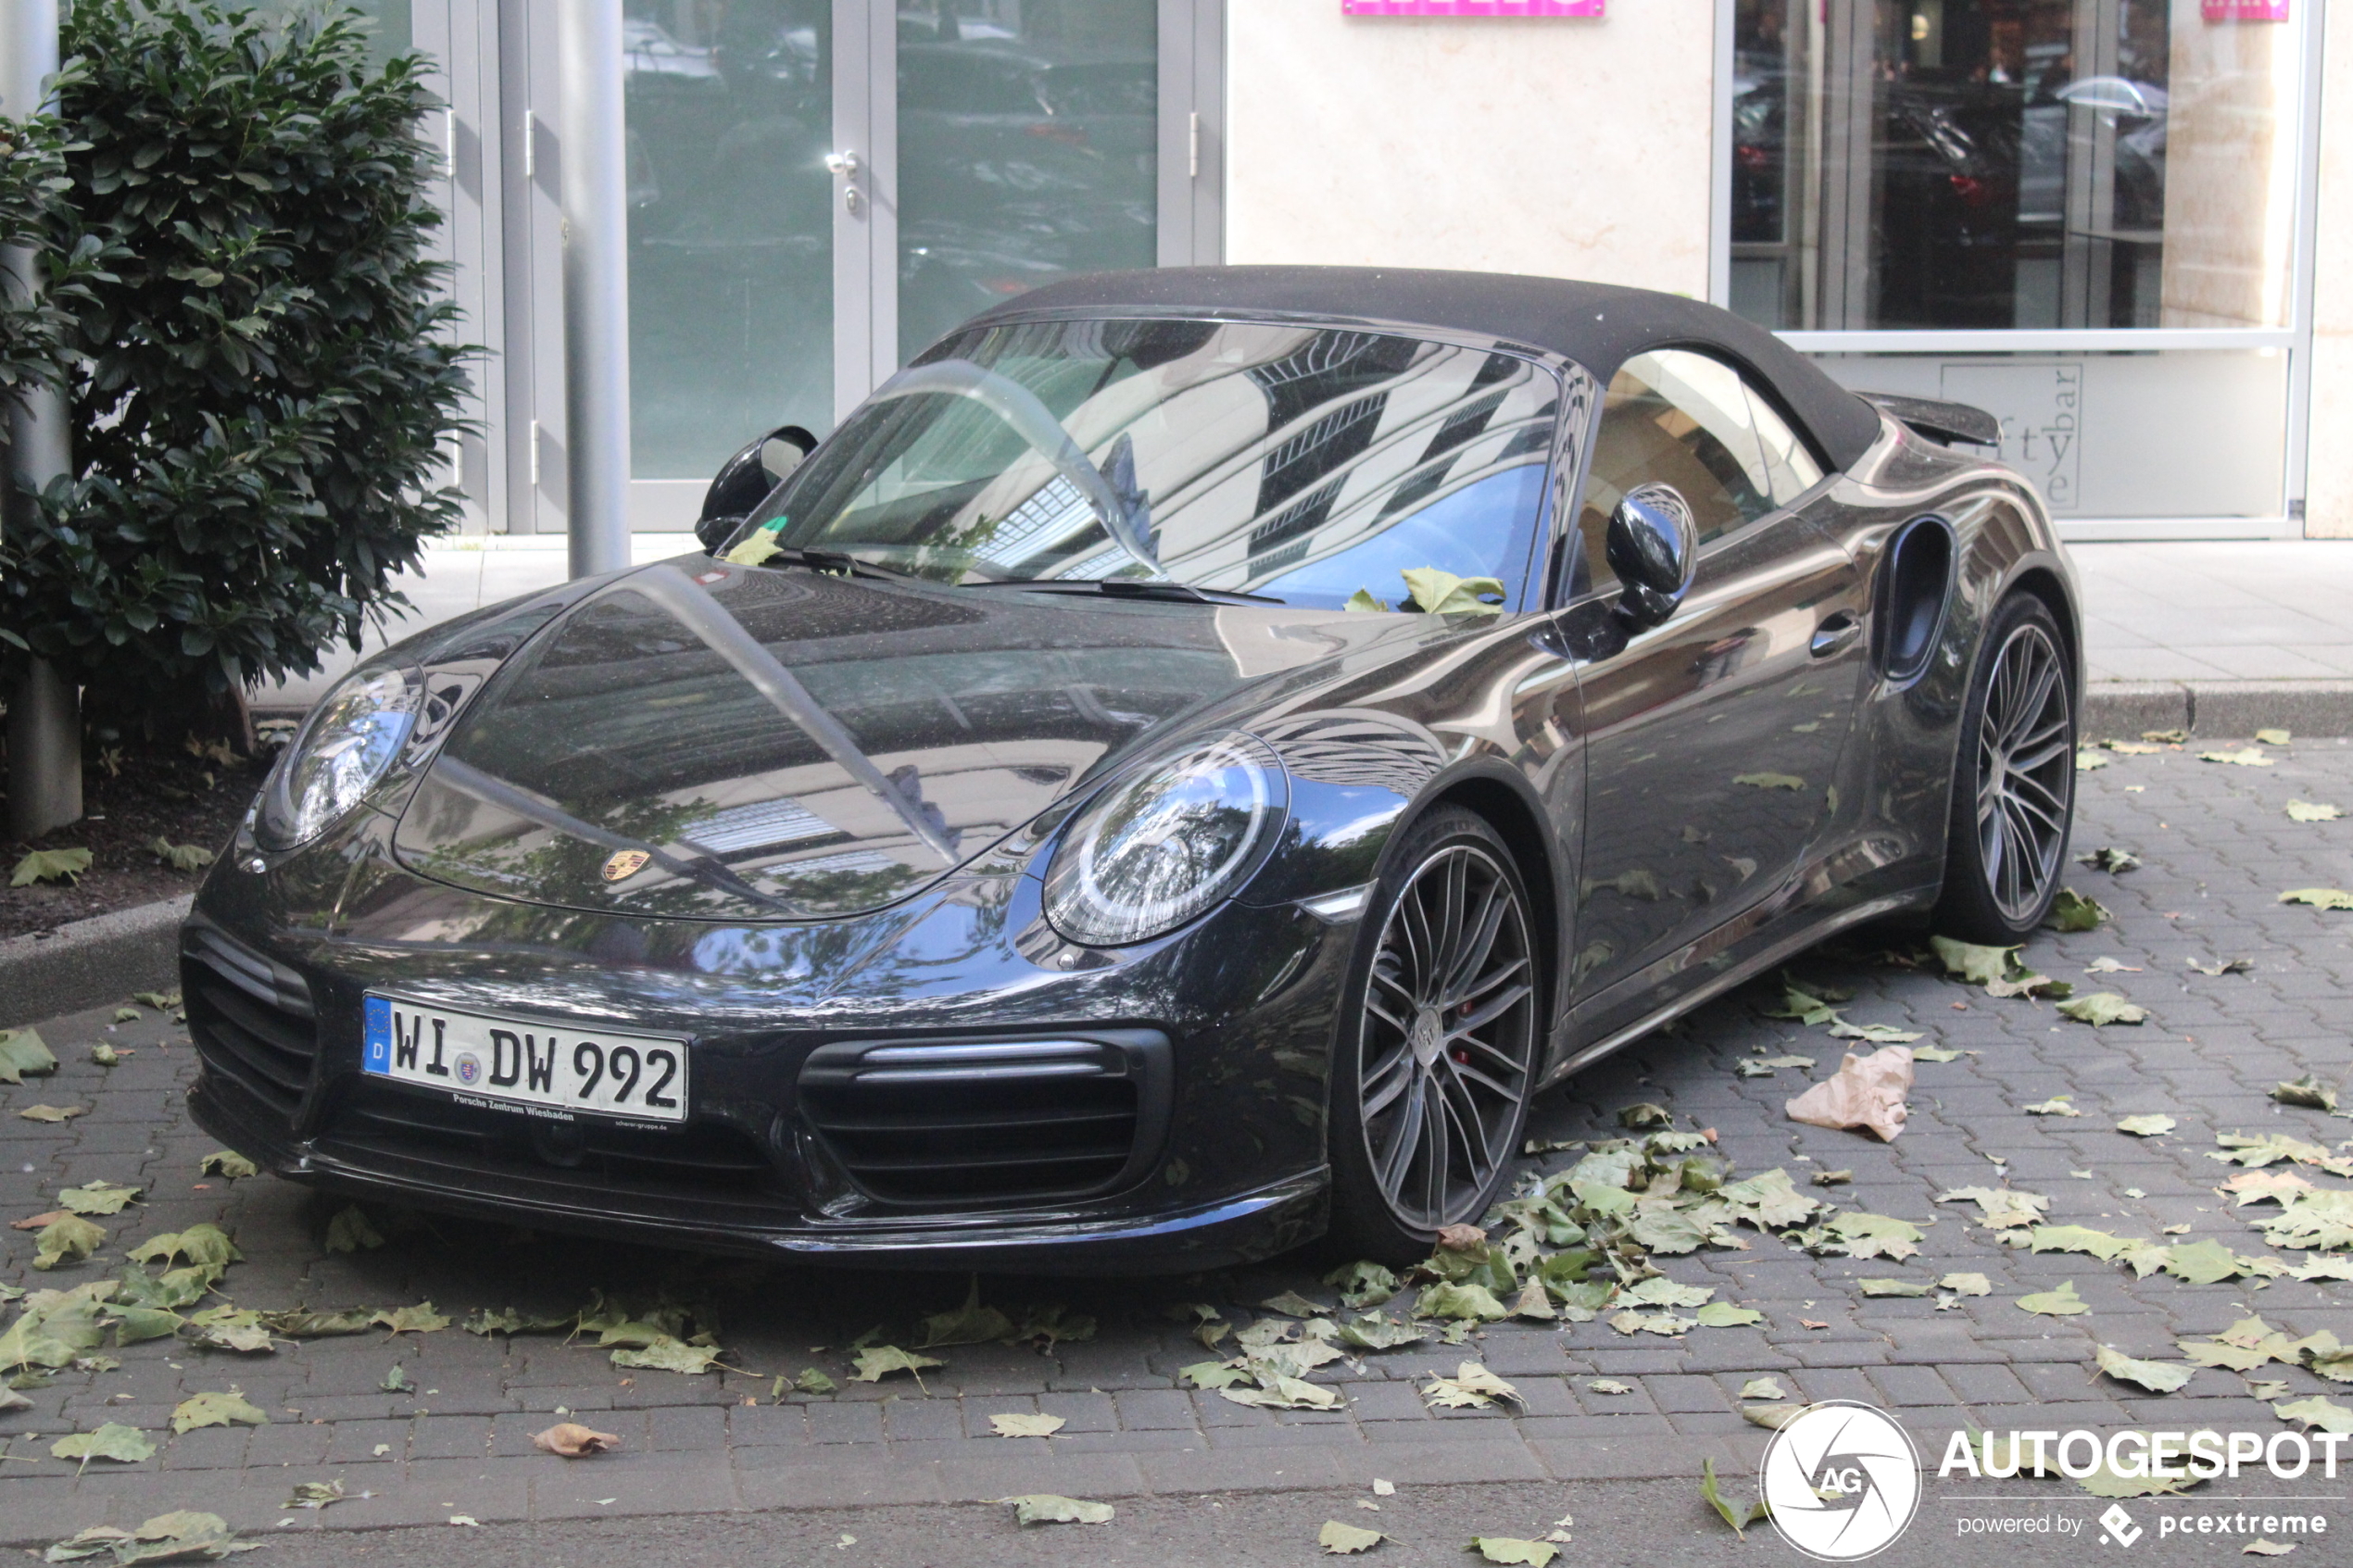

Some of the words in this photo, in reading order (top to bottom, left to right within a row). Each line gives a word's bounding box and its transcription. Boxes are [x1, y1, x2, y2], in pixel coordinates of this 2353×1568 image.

[2041, 370, 2076, 432] bar
[372, 1042, 384, 1060] D
[394, 1011, 449, 1076] WI
[489, 1028, 557, 1093] DW
[573, 1042, 677, 1108] 992
[452, 1093, 487, 1109] Porsche
[488, 1099, 524, 1114] Zentrum
[525, 1105, 574, 1122] Wiesbaden
